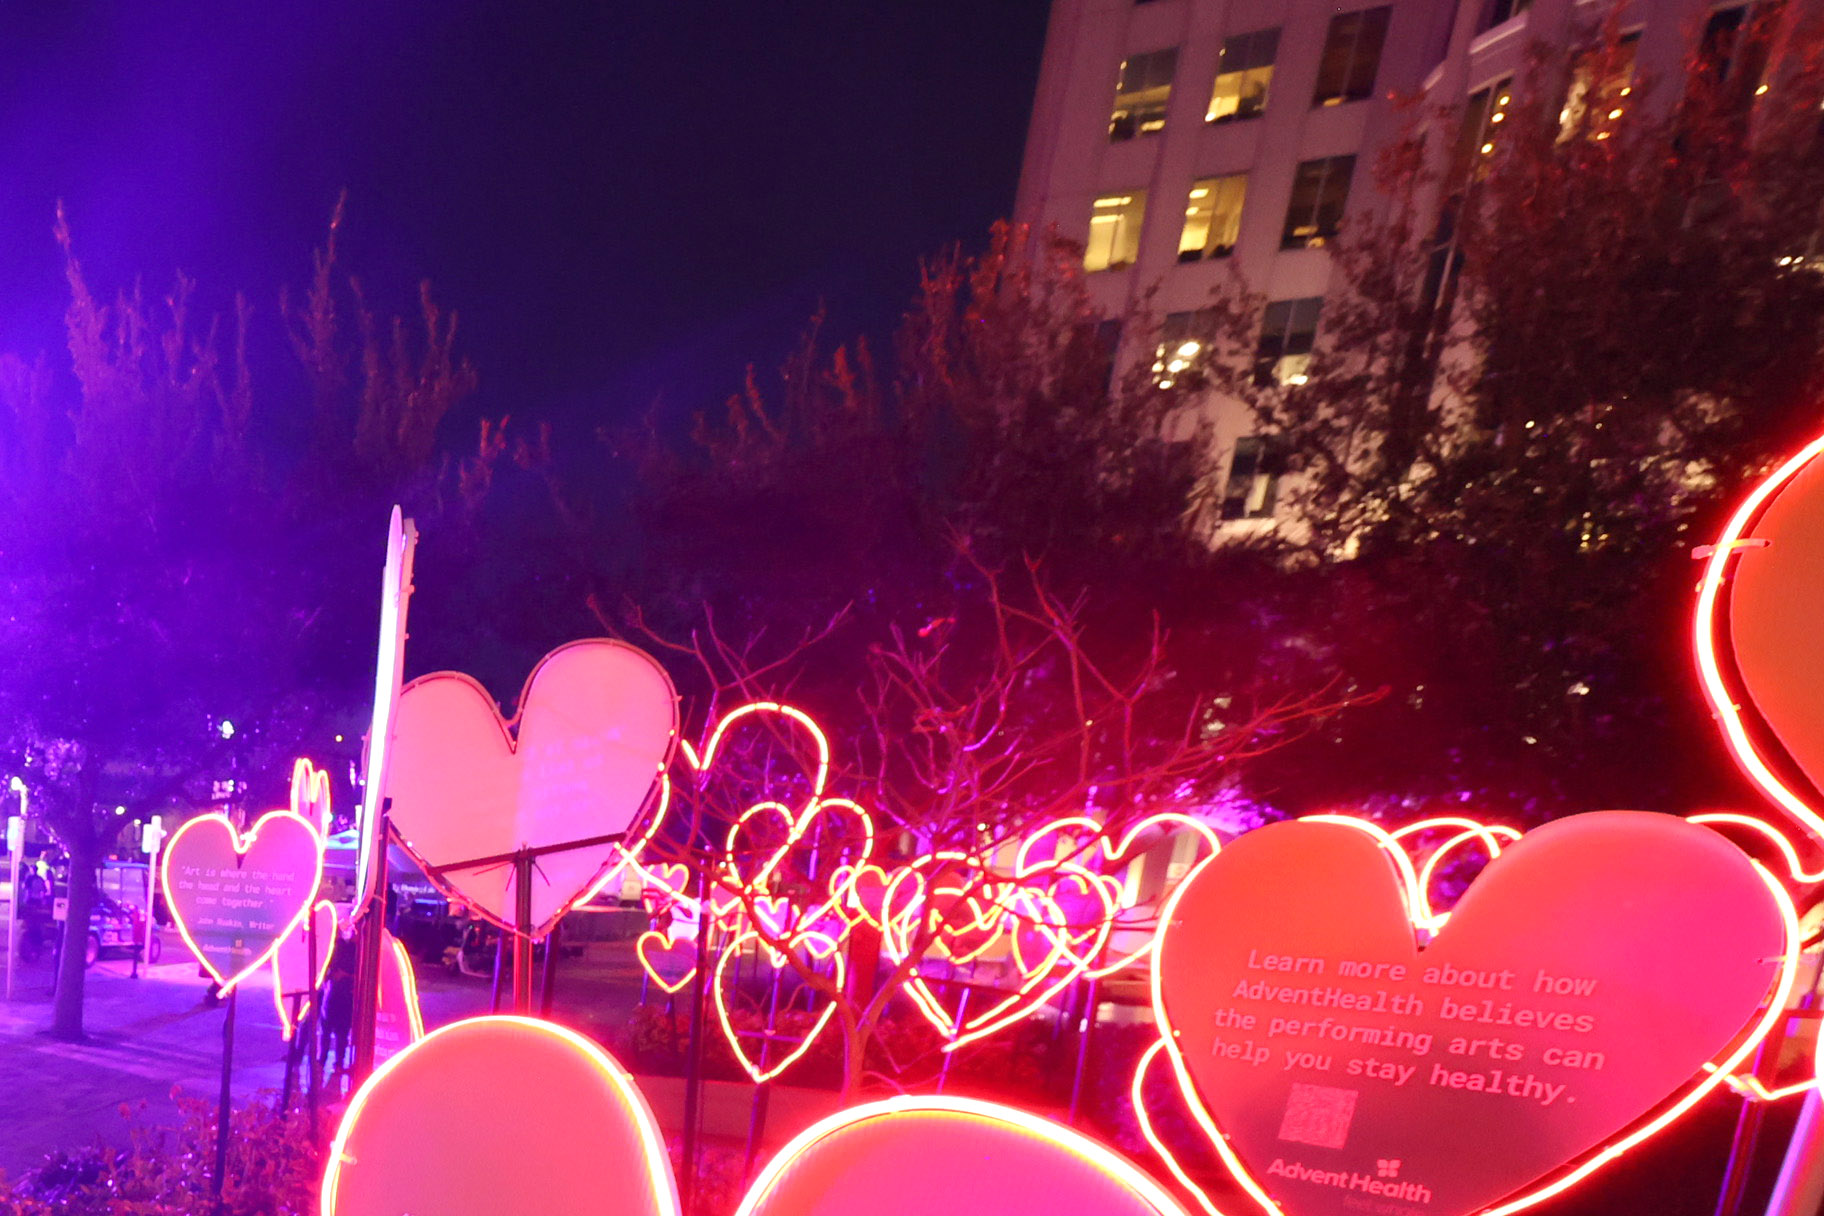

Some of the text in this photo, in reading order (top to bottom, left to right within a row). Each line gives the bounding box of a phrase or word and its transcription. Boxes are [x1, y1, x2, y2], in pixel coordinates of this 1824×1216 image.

[1248, 949, 1597, 997] Learn more about how
[1233, 978, 1595, 1033] AdventHealth believes
[1214, 1008, 1605, 1071] the performing arts can
[1211, 1037, 1577, 1106] help you stay healthy.
[1267, 1158, 1432, 1203] AdventHealth
